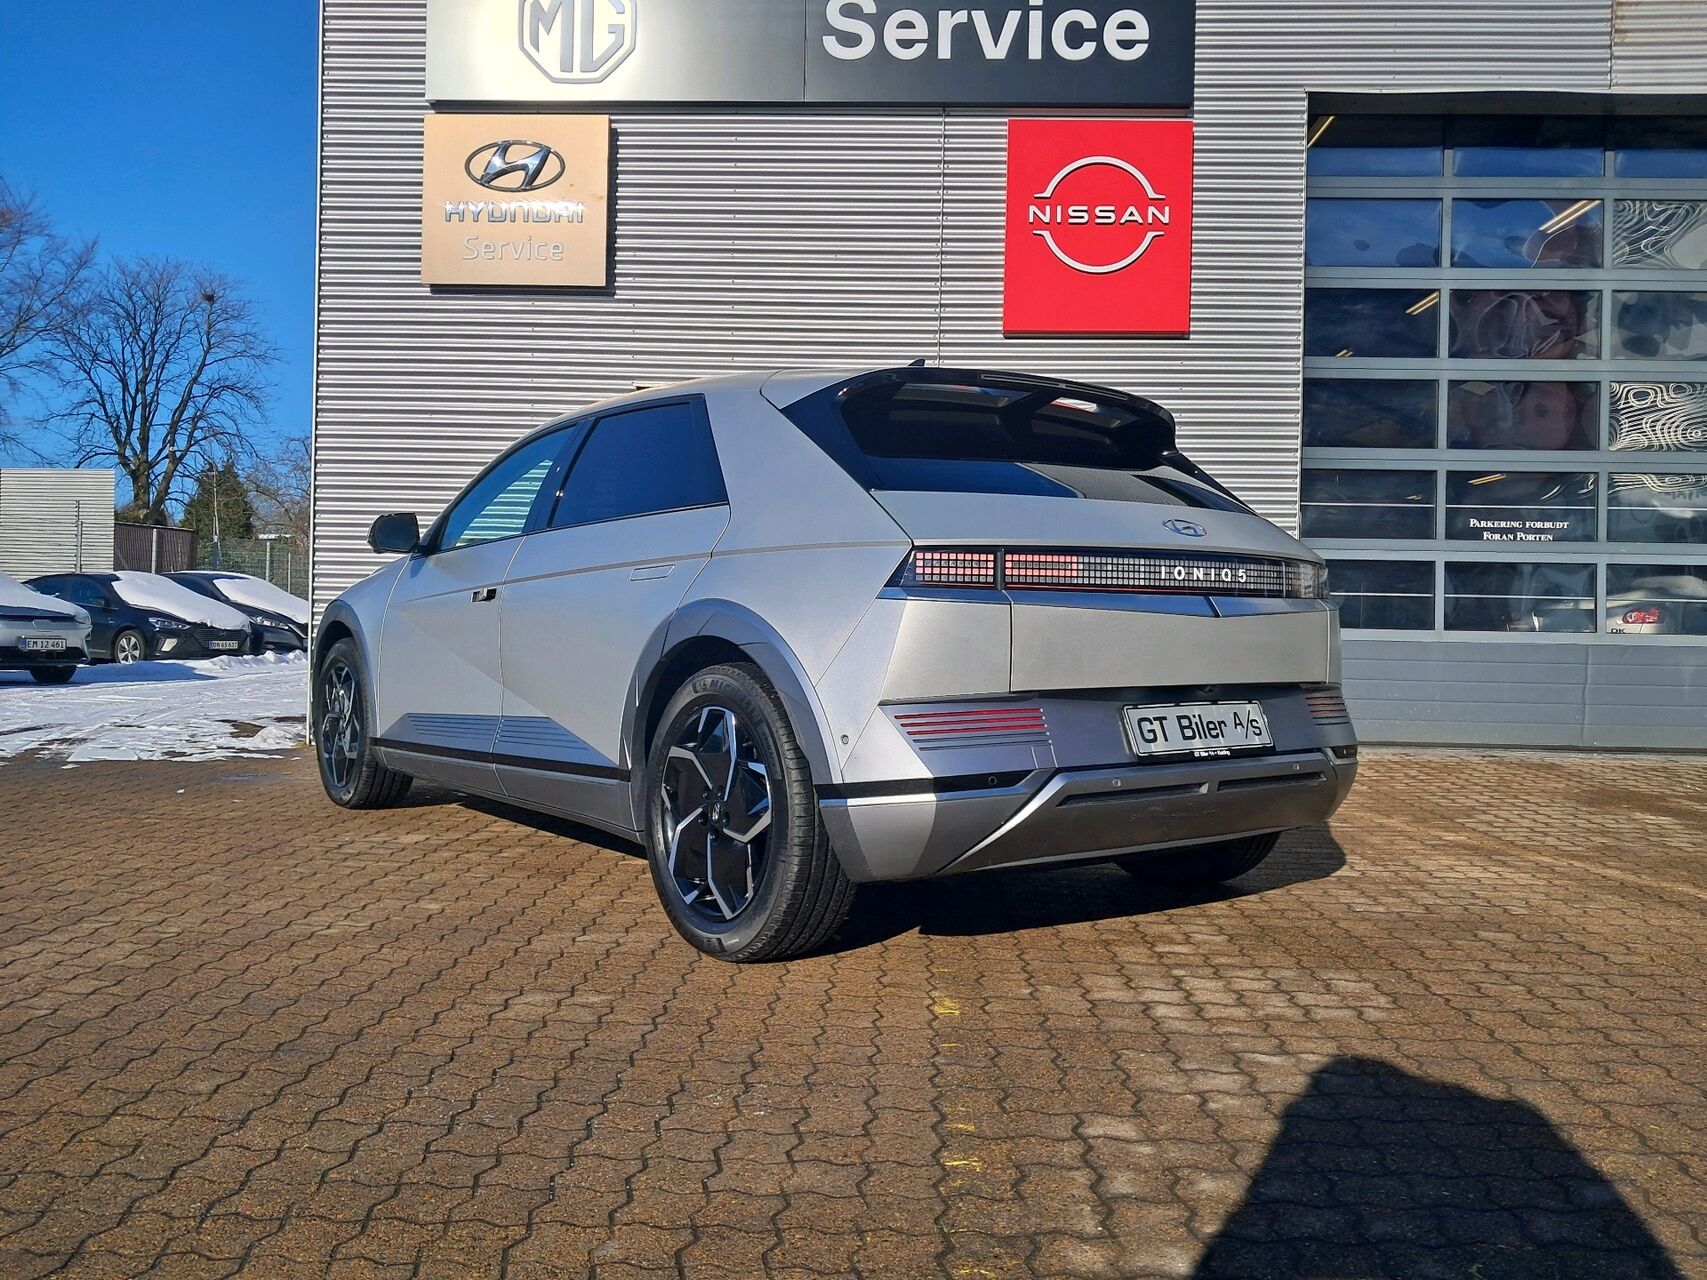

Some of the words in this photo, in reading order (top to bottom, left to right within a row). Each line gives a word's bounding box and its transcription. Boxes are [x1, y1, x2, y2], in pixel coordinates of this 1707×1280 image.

[530, 0, 625, 72] MG
[822, 0, 1150, 61] Service
[444, 200, 585, 223] HYUNDAI
[1028, 204, 1170, 224] NISSAN
[462, 235, 565, 261] Service
[1136, 716, 1169, 744] GT
[1175, 714, 1228, 741] Biler
